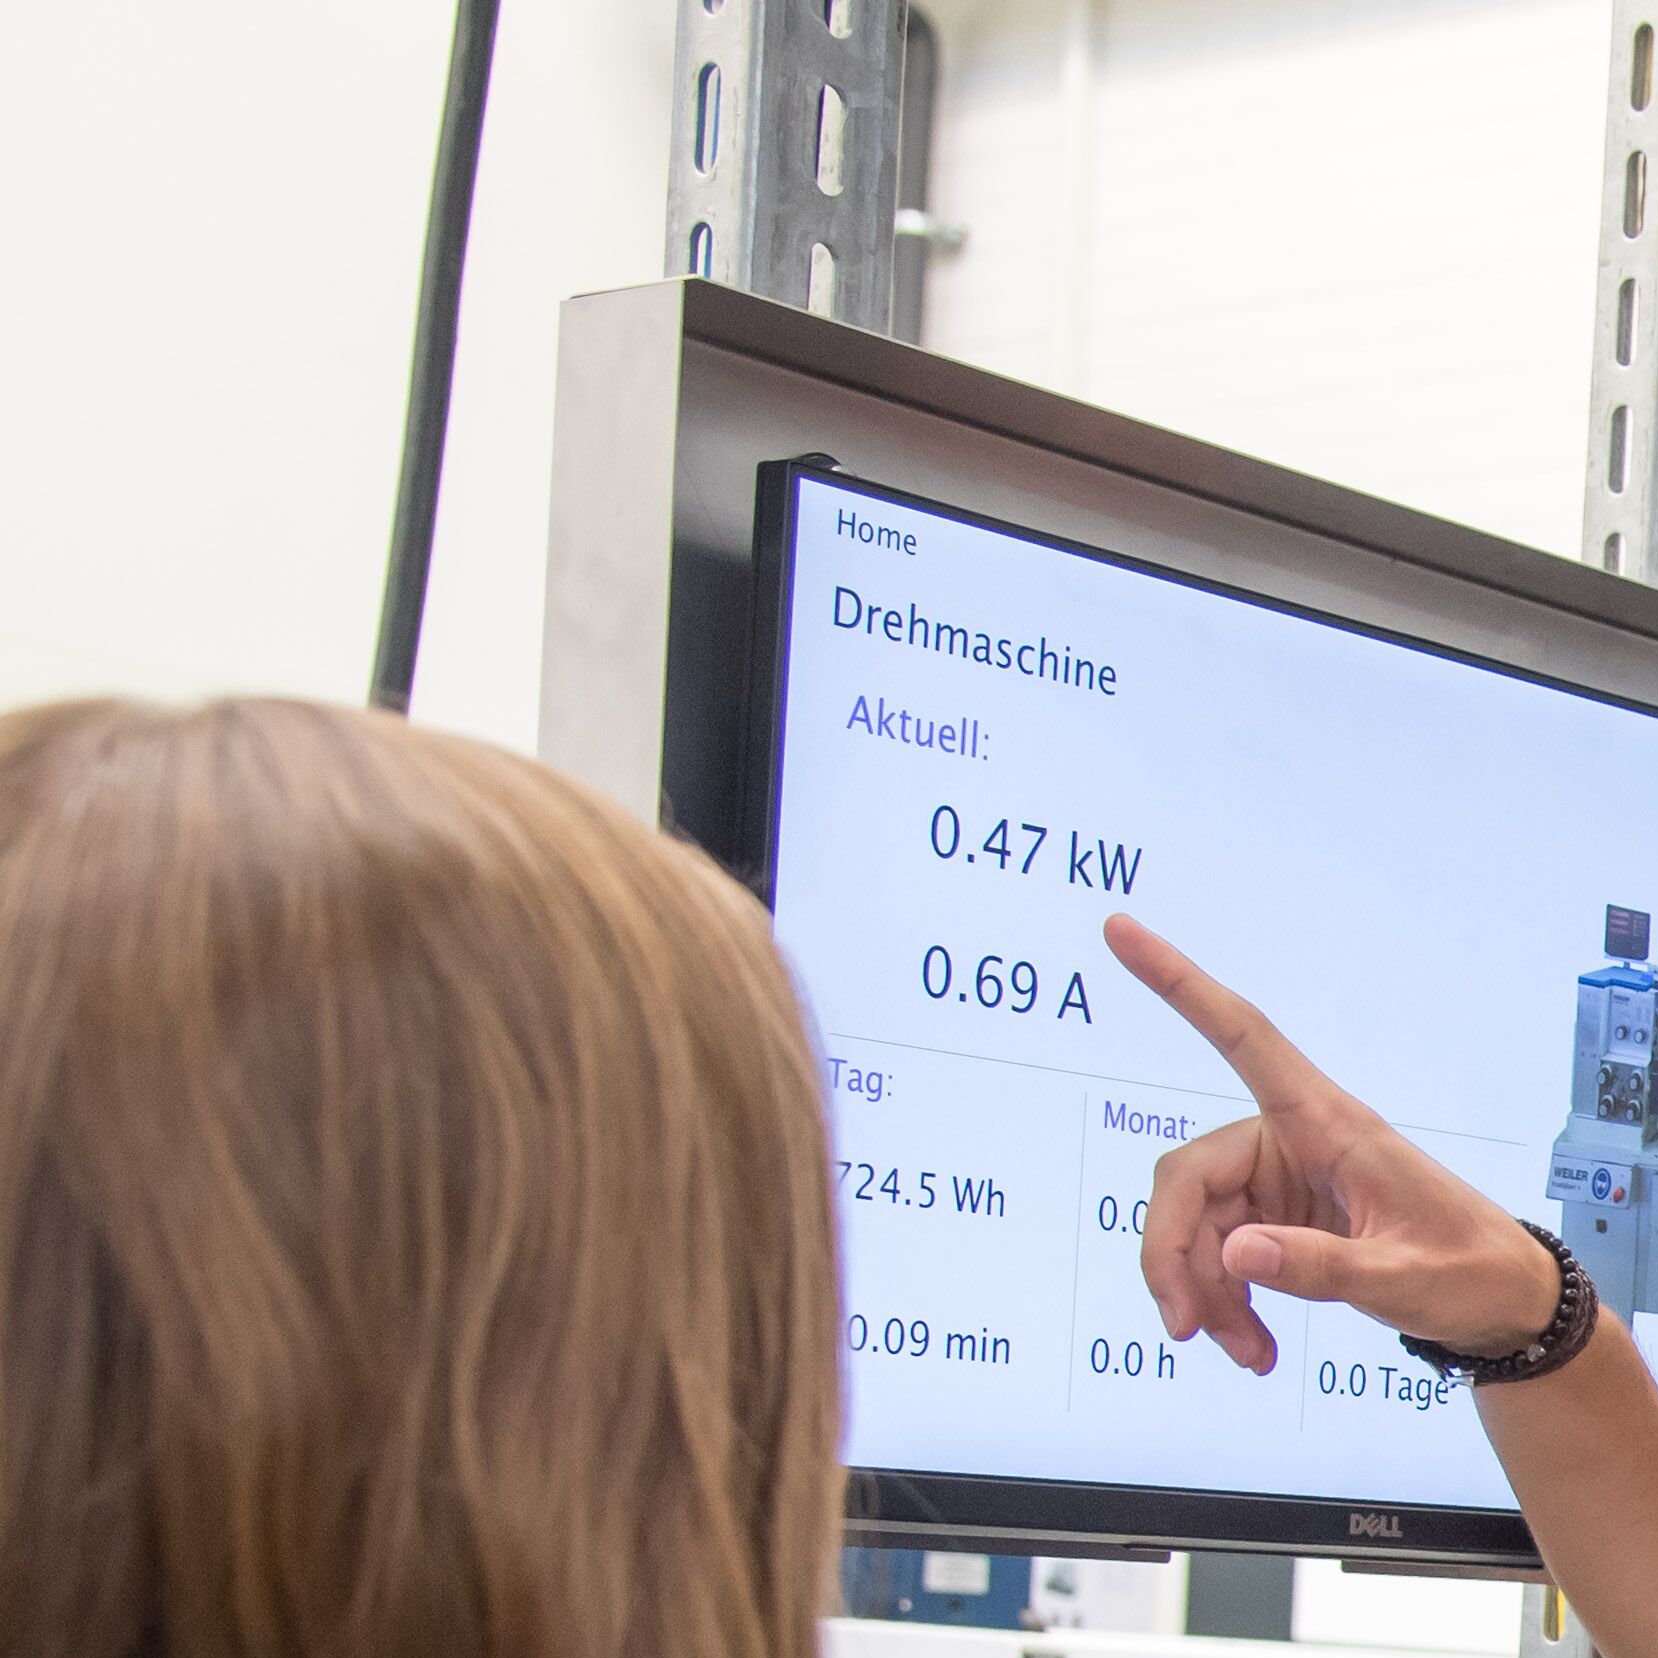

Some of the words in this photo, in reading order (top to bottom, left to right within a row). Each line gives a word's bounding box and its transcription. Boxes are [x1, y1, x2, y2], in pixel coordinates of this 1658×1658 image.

[836, 508, 918, 555] Home
[832, 586, 1118, 695] Drehmaschine
[847, 694, 990, 761] Aktuell:
[930, 804, 1048, 875] 0.47
[1068, 830, 1143, 896] kW
[922, 944, 1039, 1014] 0.69
[1057, 971, 1093, 1025] A
[827, 1057, 893, 1103] Tag:
[1104, 1100, 1197, 1141] Monat:
[952, 1175, 1006, 1218] Wh
[1553, 1166, 1589, 1182] WEILER
[945, 1327, 1011, 1365] min
[1090, 1337, 1144, 1377] 0.0
[1157, 1338, 1176, 1380] h
[1319, 1360, 1367, 1397] 0.0
[1378, 1366, 1450, 1411] Tage
[1349, 1512, 1403, 1539] DELL
